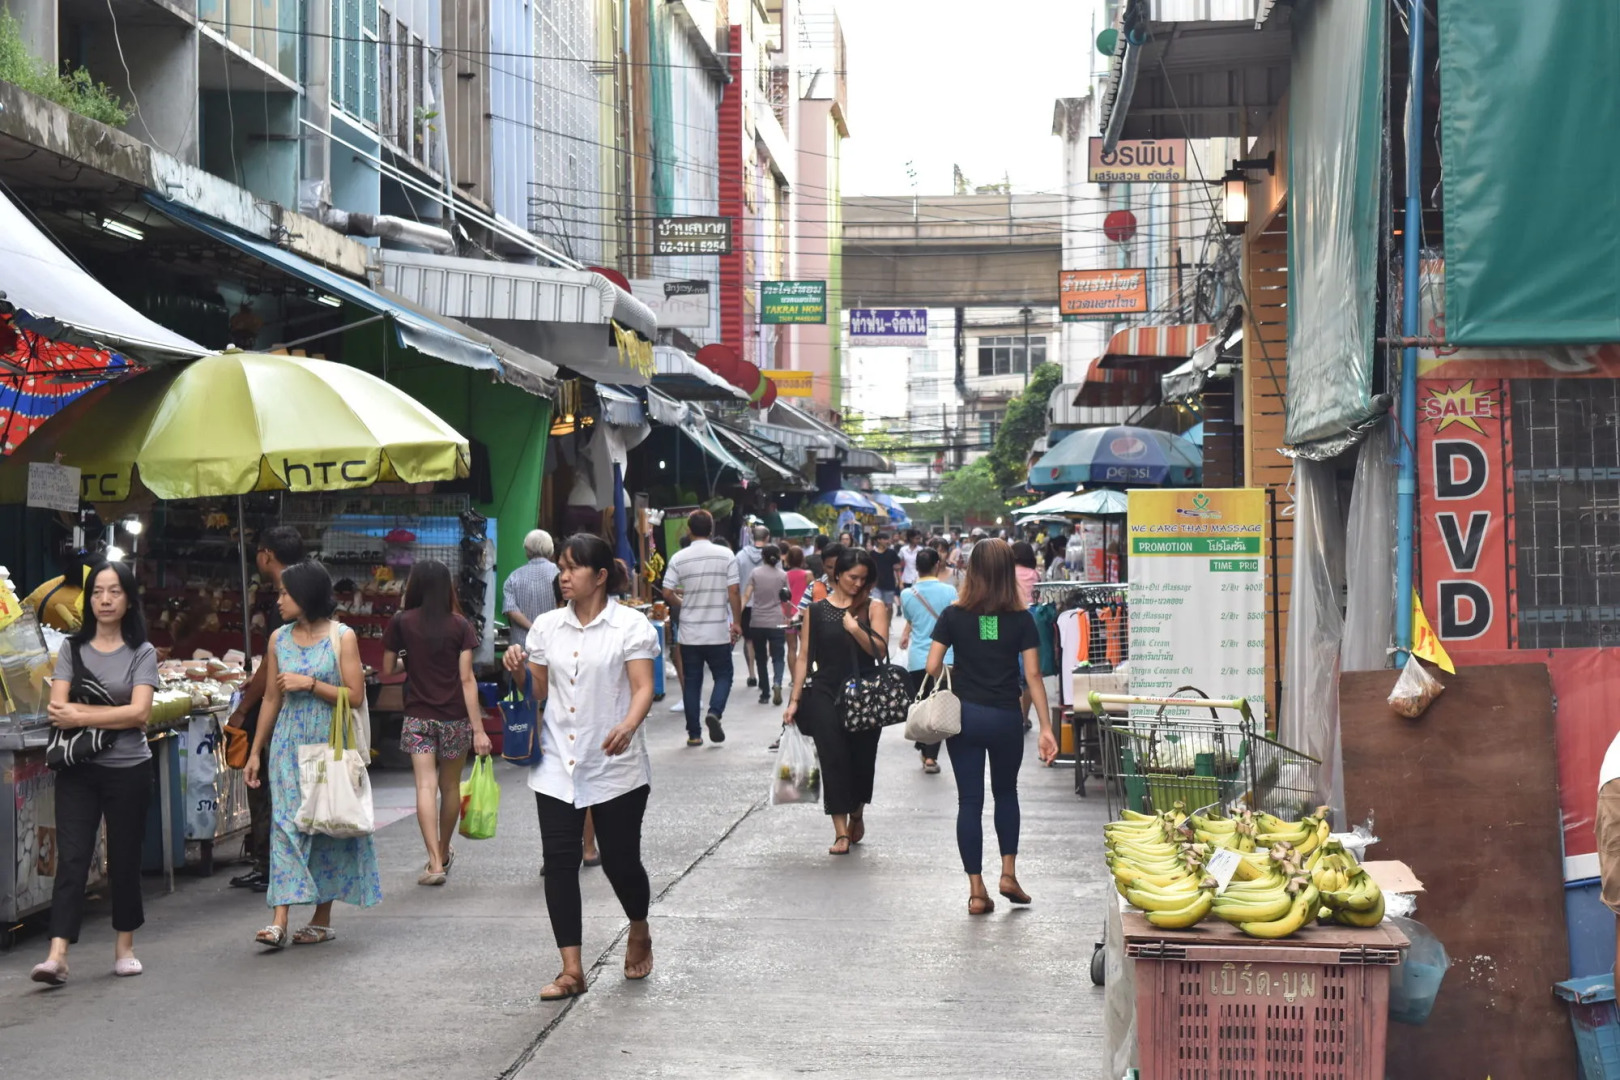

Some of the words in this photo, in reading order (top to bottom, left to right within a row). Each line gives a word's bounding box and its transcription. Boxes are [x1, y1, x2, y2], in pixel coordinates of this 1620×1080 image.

[658, 219, 726, 236] บ้านสบาย
[765, 305, 799, 314] TAKRAI
[802, 305, 823, 314] HOM
[851, 310, 926, 333] ทำฟัน-จัดฟัน
[1425, 395, 1491, 419] SALE
[1106, 466, 1150, 480] pepsi
[1131, 524, 1147, 533] WE
[1149, 524, 1178, 533] CARE
[1211, 524, 1263, 534] MASSAGE
[1139, 542, 1193, 552] PROMOTION
[1207, 537, 1246, 552] โปรโมชั่น
[1432, 438, 1494, 641] DVD
[1213, 561, 1233, 570] TIME
[1239, 561, 1258, 570] PRIC
[1210, 962, 1316, 1002] เบิร์ด-บูม
